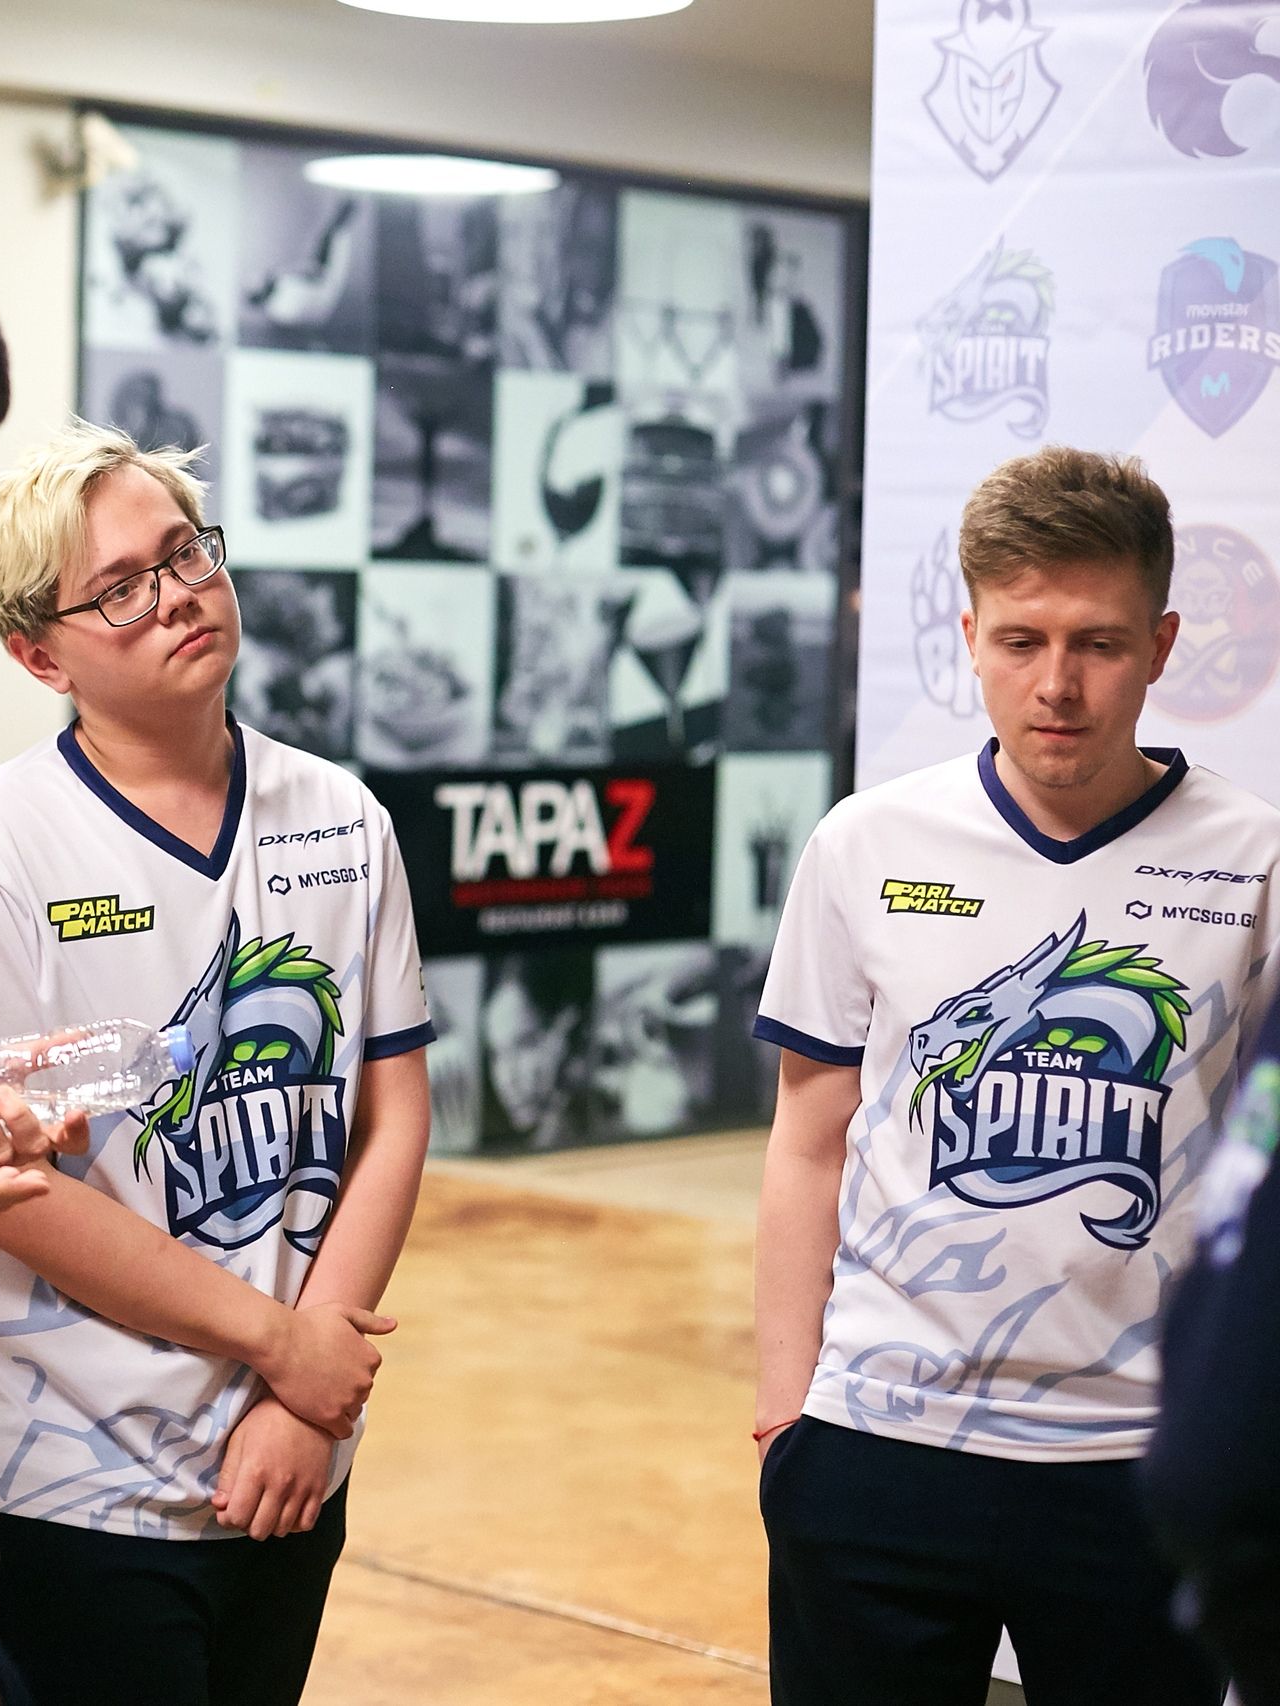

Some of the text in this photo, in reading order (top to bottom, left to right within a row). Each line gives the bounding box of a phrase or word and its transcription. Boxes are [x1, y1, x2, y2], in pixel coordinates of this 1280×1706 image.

[1186, 303, 1249, 319] movistar
[1151, 322, 1280, 363] RIDERS
[933, 335, 1048, 400] SPIRIT
[1173, 533, 1265, 588] NCE
[258, 818, 365, 849] DXRACER
[434, 778, 656, 881] TAPAZ
[883, 881, 951, 899] PARI
[1134, 865, 1268, 887] DXRACER
[50, 898, 117, 923] PARI
[890, 896, 981, 915] MATCH
[62, 910, 151, 938] MATCH
[1023, 1050, 1083, 1072] TEAM
[220, 1063, 275, 1092] TEAM
[935, 1070, 1164, 1171] SPIRIT
